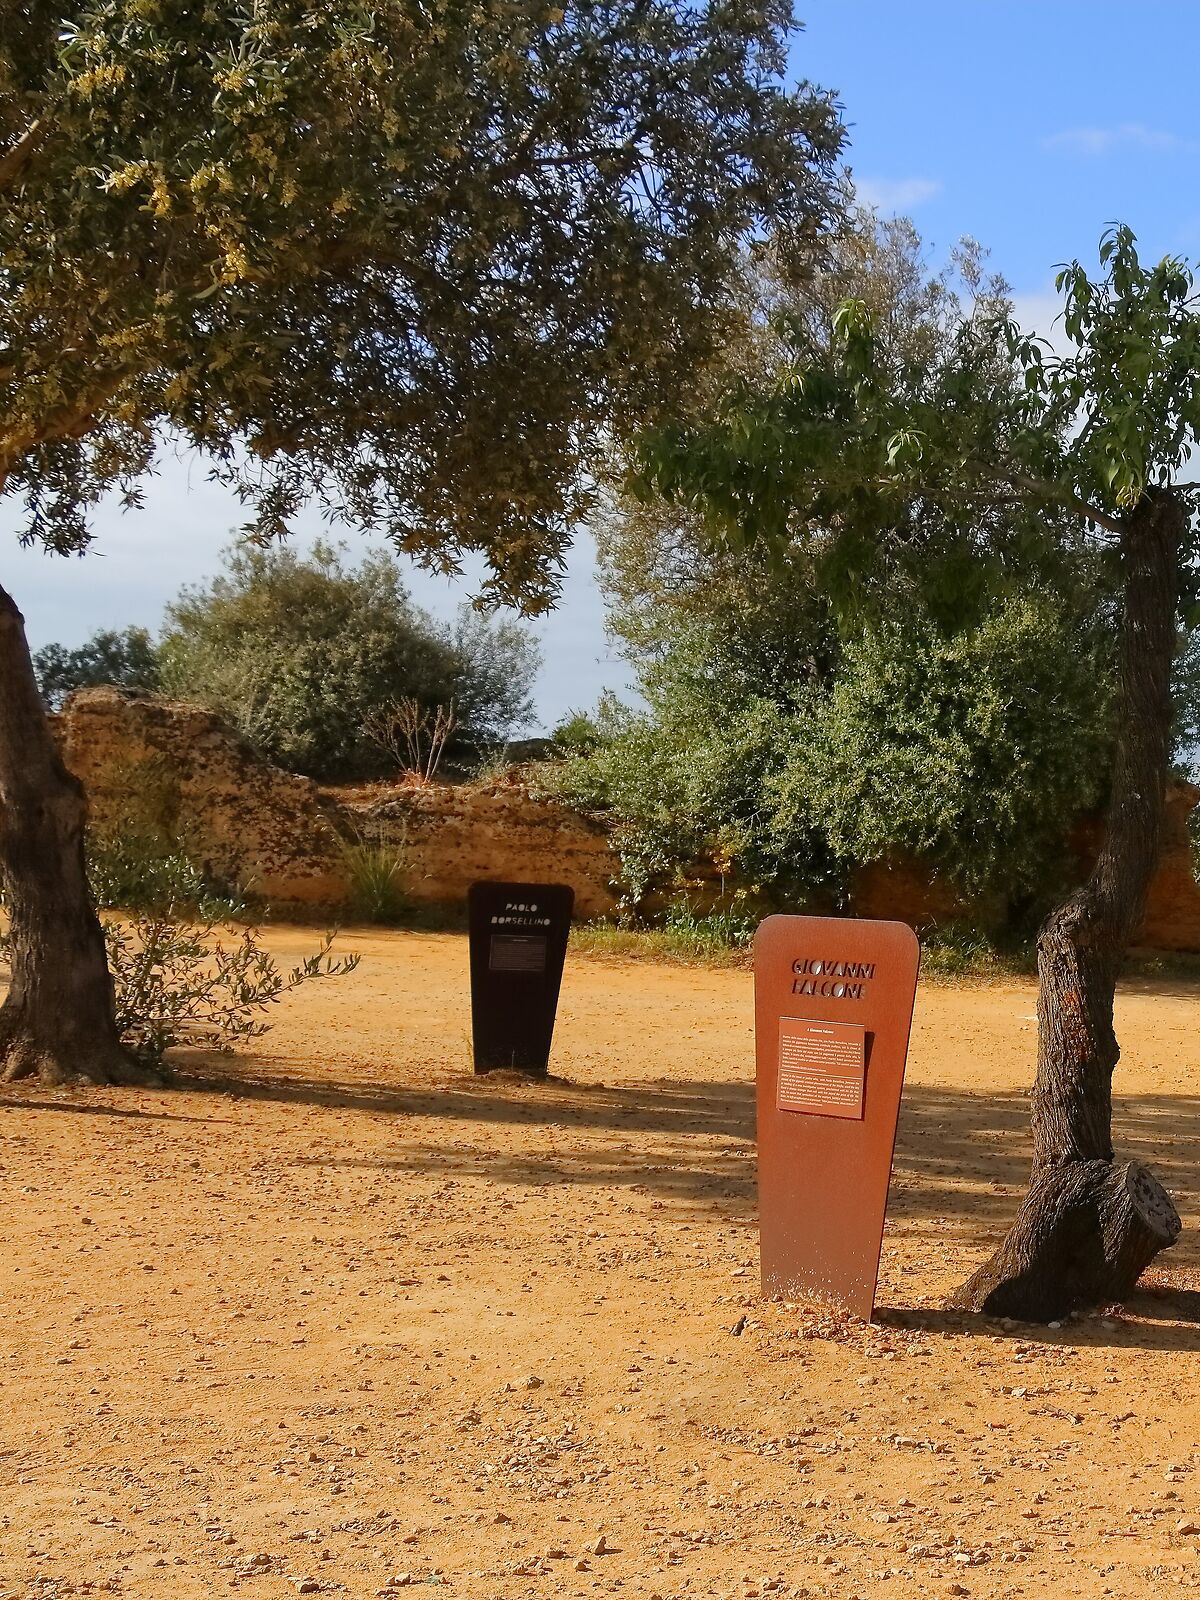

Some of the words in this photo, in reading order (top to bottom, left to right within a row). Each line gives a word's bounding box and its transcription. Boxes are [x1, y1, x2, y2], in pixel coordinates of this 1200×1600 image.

[505, 903, 538, 912] PAOLO
[491, 916, 551, 926] BORSELLINO
[791, 958, 876, 979] GIOVANNI
[791, 979, 865, 999] FALCONE
